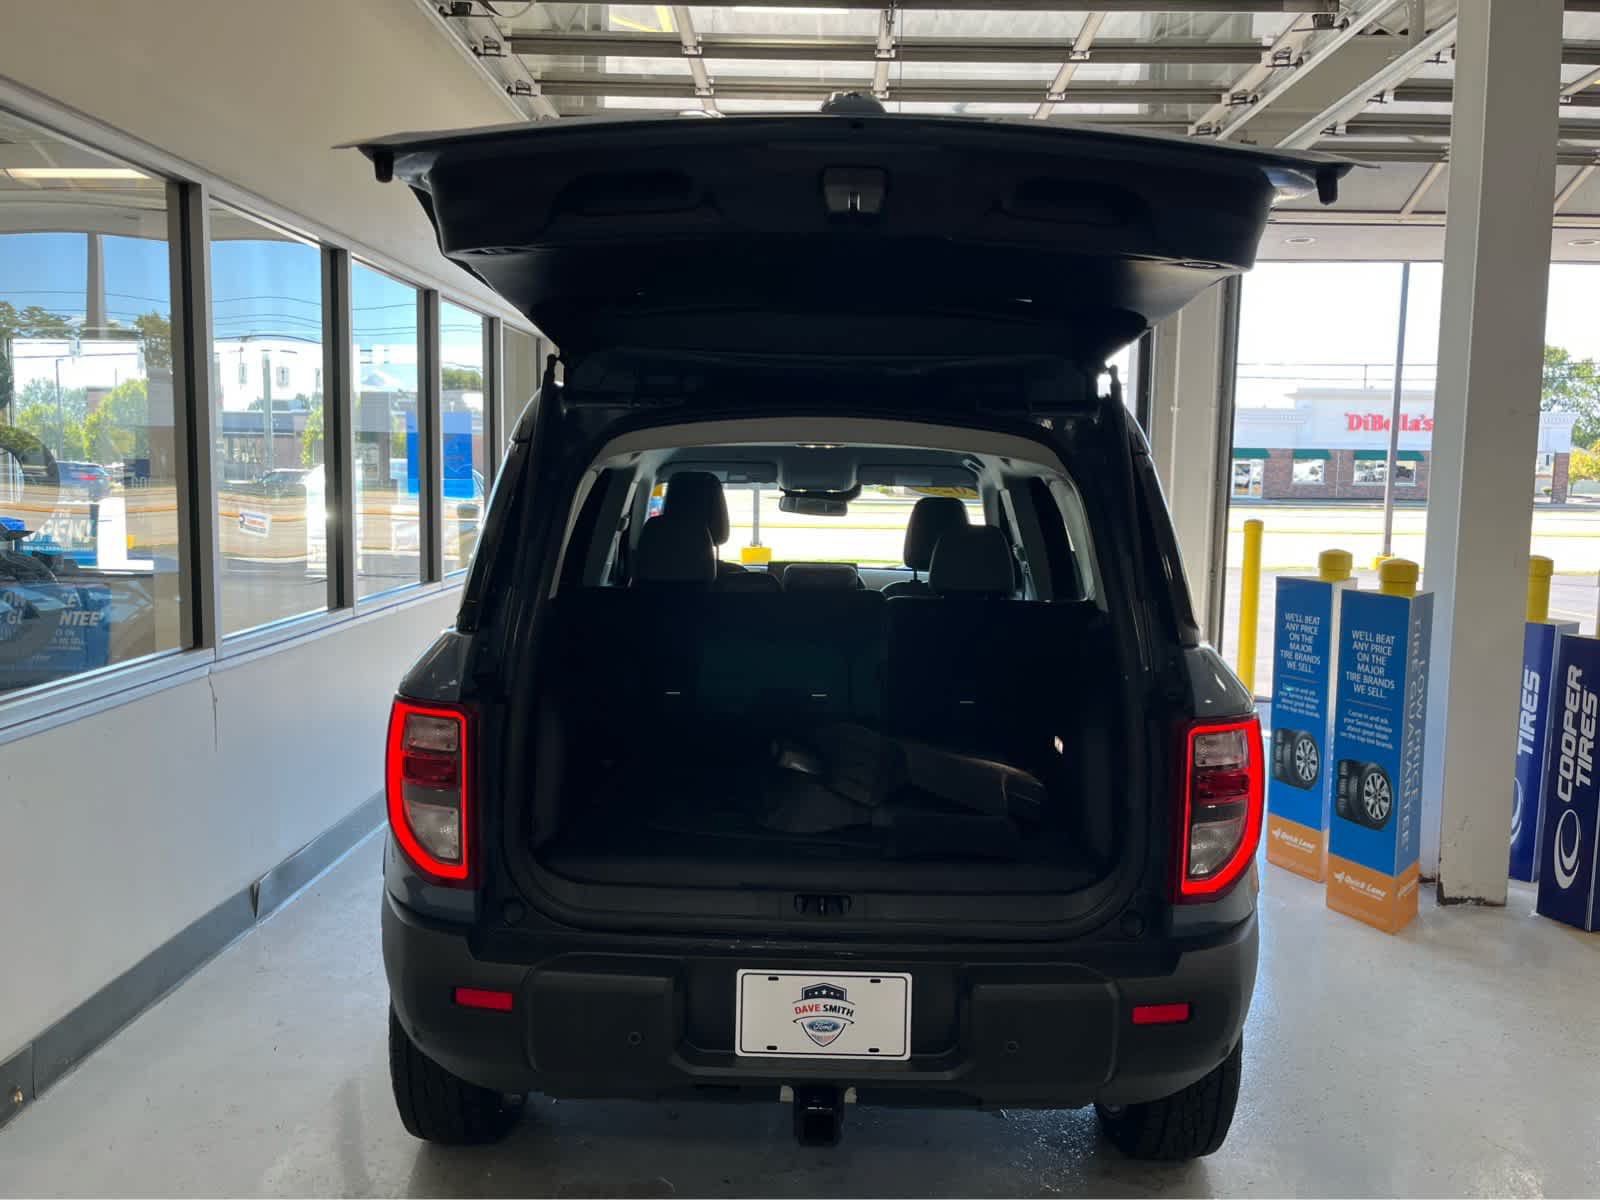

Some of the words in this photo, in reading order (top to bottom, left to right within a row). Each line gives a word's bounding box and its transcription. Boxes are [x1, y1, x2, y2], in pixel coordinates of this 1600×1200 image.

[1344, 412, 1434, 433] DiBela's
[1304, 615, 1320, 625] BEAT
[1285, 622, 1299, 632] ANY
[1300, 624, 1319, 636] PRICE
[1289, 632, 1300, 642] ON
[1301, 634, 1313, 645] THE
[1352, 629, 1374, 642] WE'LL
[1376, 632, 1395, 645] BEAT
[1289, 642, 1313, 654] MAJOR
[1352, 640, 1369, 651] ANY
[1370, 643, 1393, 656] PRICE
[1280, 648, 1293, 660] TIRE
[1294, 652, 1321, 665] BRANDS
[1356, 651, 1369, 661] ON
[1371, 654, 1387, 666] THE
[1286, 659, 1297, 670] WE
[1357, 662, 1385, 676] MAJOR
[1345, 671, 1361, 683] TIRE
[1362, 674, 1395, 689] BRANDS
[1353, 682, 1366, 695] WE
[1517, 667, 1540, 755] TIRES
[1557, 664, 1583, 802] COOPER
[1576, 688, 1598, 787] TIRES
[795, 1004, 820, 1015] DAVE
[823, 1004, 854, 1016] SMITH
